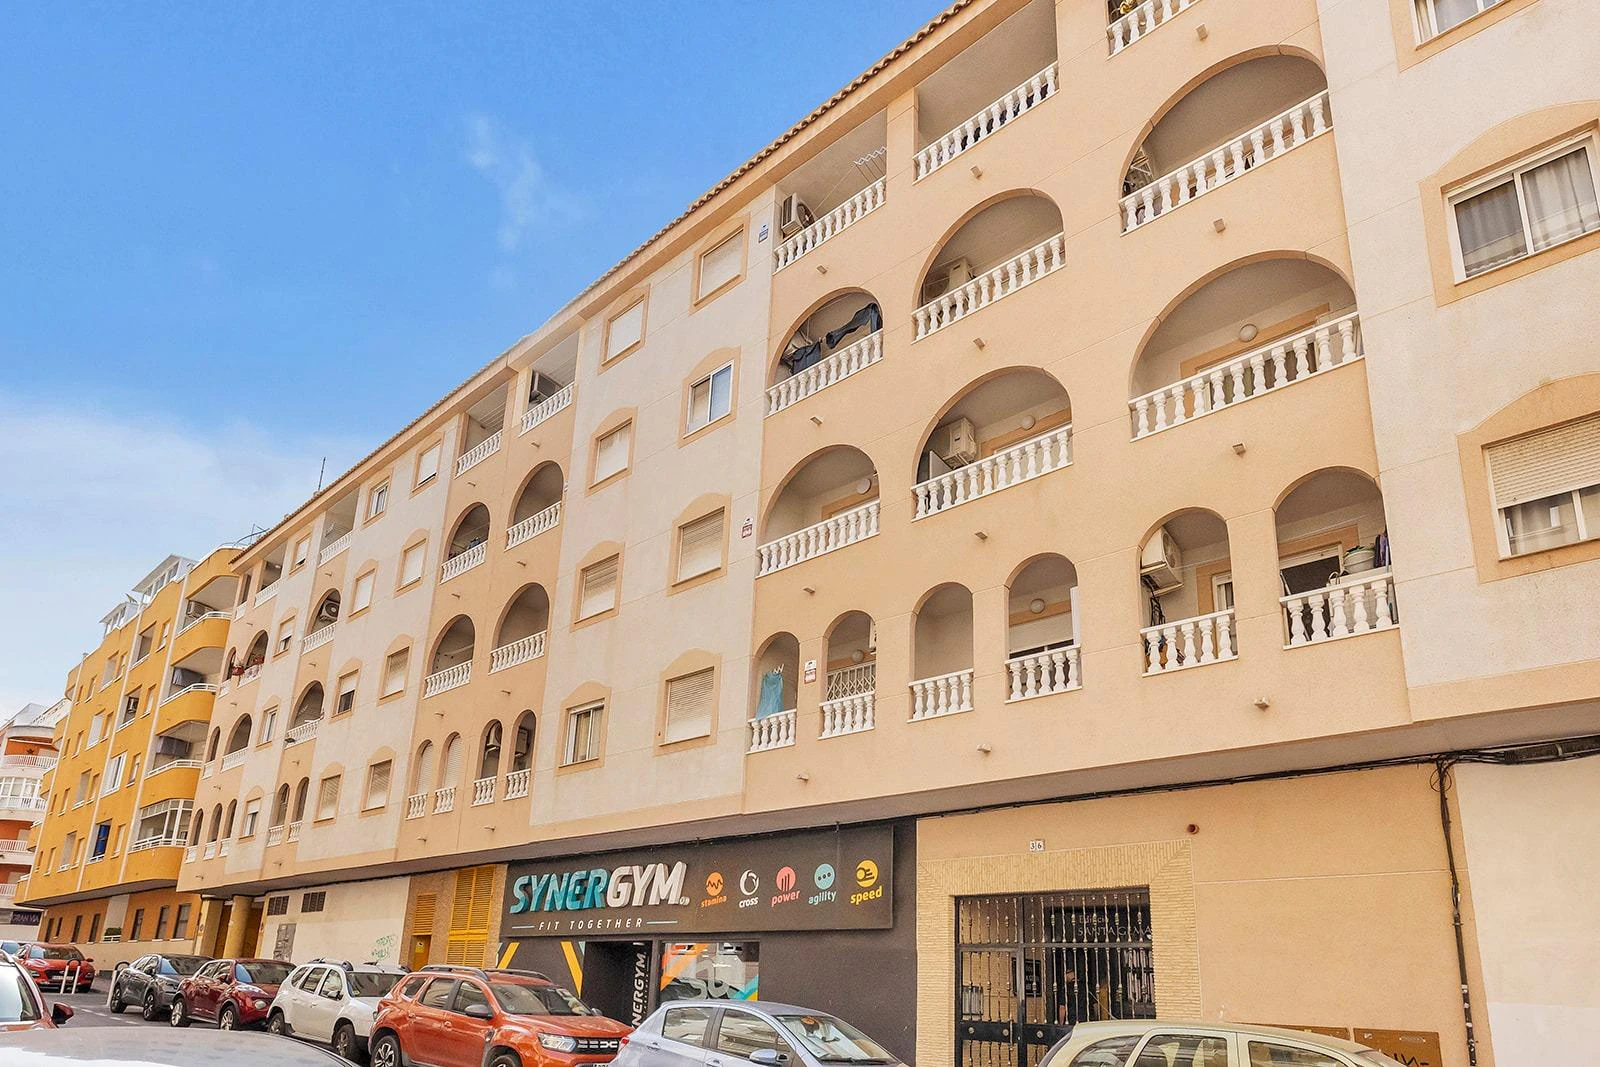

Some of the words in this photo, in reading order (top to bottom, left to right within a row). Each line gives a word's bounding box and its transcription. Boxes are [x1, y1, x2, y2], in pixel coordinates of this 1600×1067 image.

[510, 861, 687, 913] SYNERGYM
[701, 894, 727, 908] stamina
[739, 897, 758, 908] cross
[771, 890, 800, 907] power
[808, 890, 837, 905] agility
[850, 886, 883, 905] speed
[538, 921, 560, 931] FIT
[569, 917, 642, 930] TOGETHER
[1118, 926, 1152, 936] GMA
